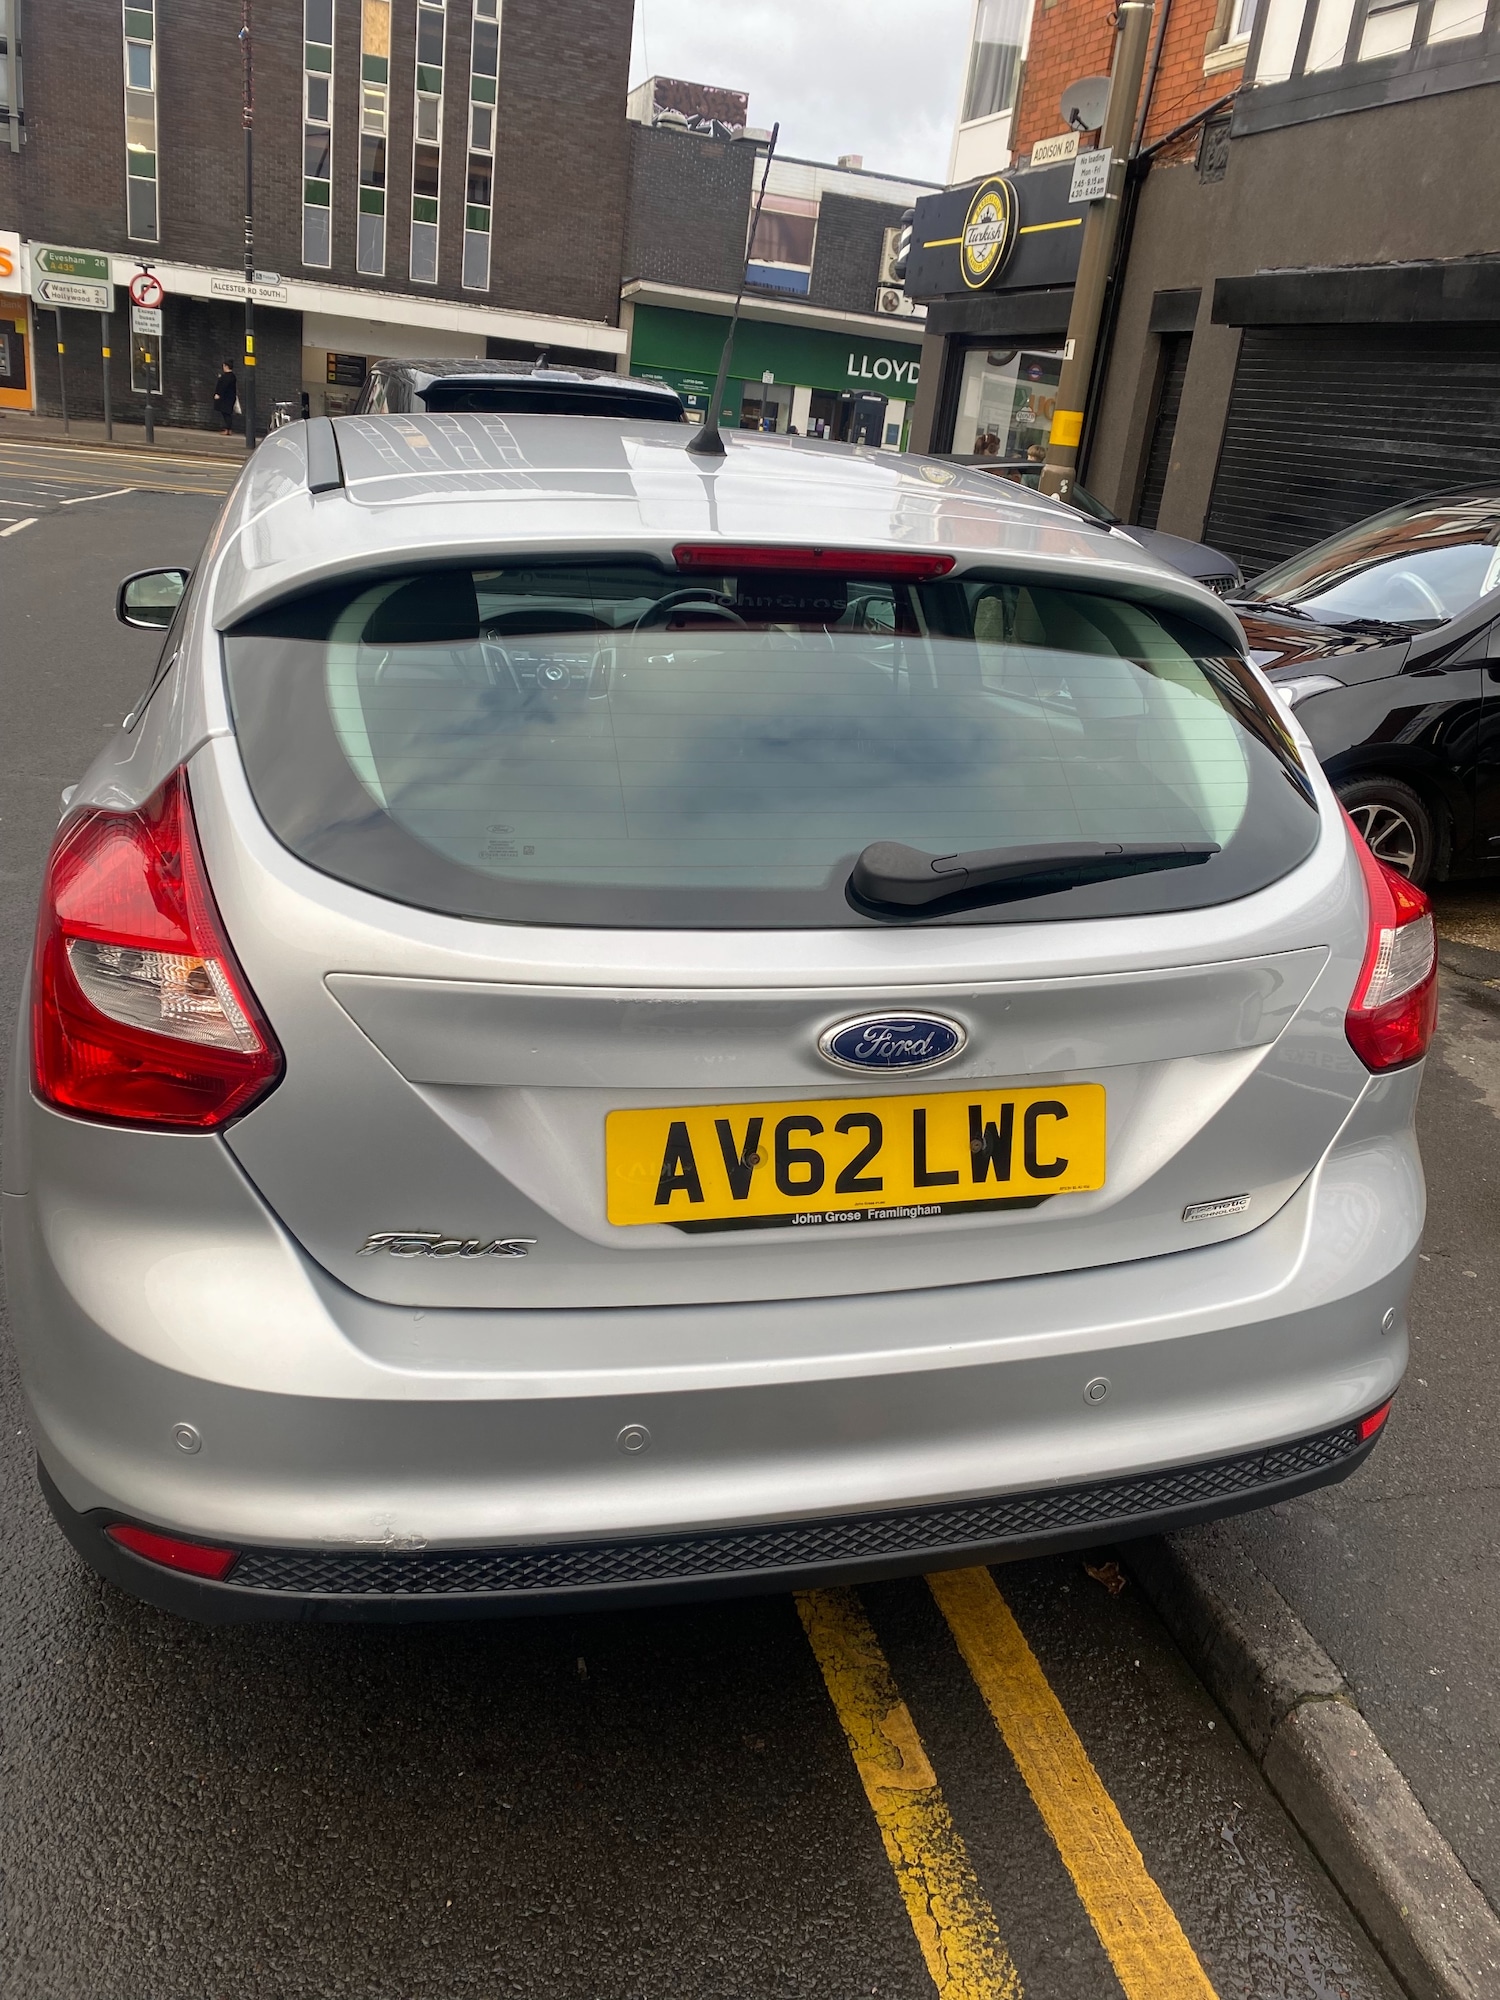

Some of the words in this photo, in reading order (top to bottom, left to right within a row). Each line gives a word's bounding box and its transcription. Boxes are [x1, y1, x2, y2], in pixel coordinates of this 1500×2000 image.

[1033, 142, 1063, 160] ADDISON
[1064, 139, 1075, 154] RD
[1080, 157, 1087, 165] No
[1088, 154, 1105, 163] loading
[1081, 168, 1090, 176] Mon
[967, 222, 1002, 244] Turkish
[49, 252, 86, 265] Evesham
[94, 258, 106, 267] 26
[51, 284, 87, 295] Warstock
[51, 291, 91, 303] Hollywood
[213, 282, 246, 293] ALCESTER
[247, 287, 257, 295] RD
[259, 289, 281, 298] SOUTH
[854, 1024, 936, 1059] Ford
[654, 1112, 883, 1206] AV62
[913, 1100, 1069, 1187] LWC
[791, 1213, 822, 1225] John
[825, 1210, 862, 1223] Grose
[867, 1204, 942, 1219] Framlingham
[1191, 1205, 1246, 1220] TECHNOLOGY
[355, 1231, 538, 1259] Focus
